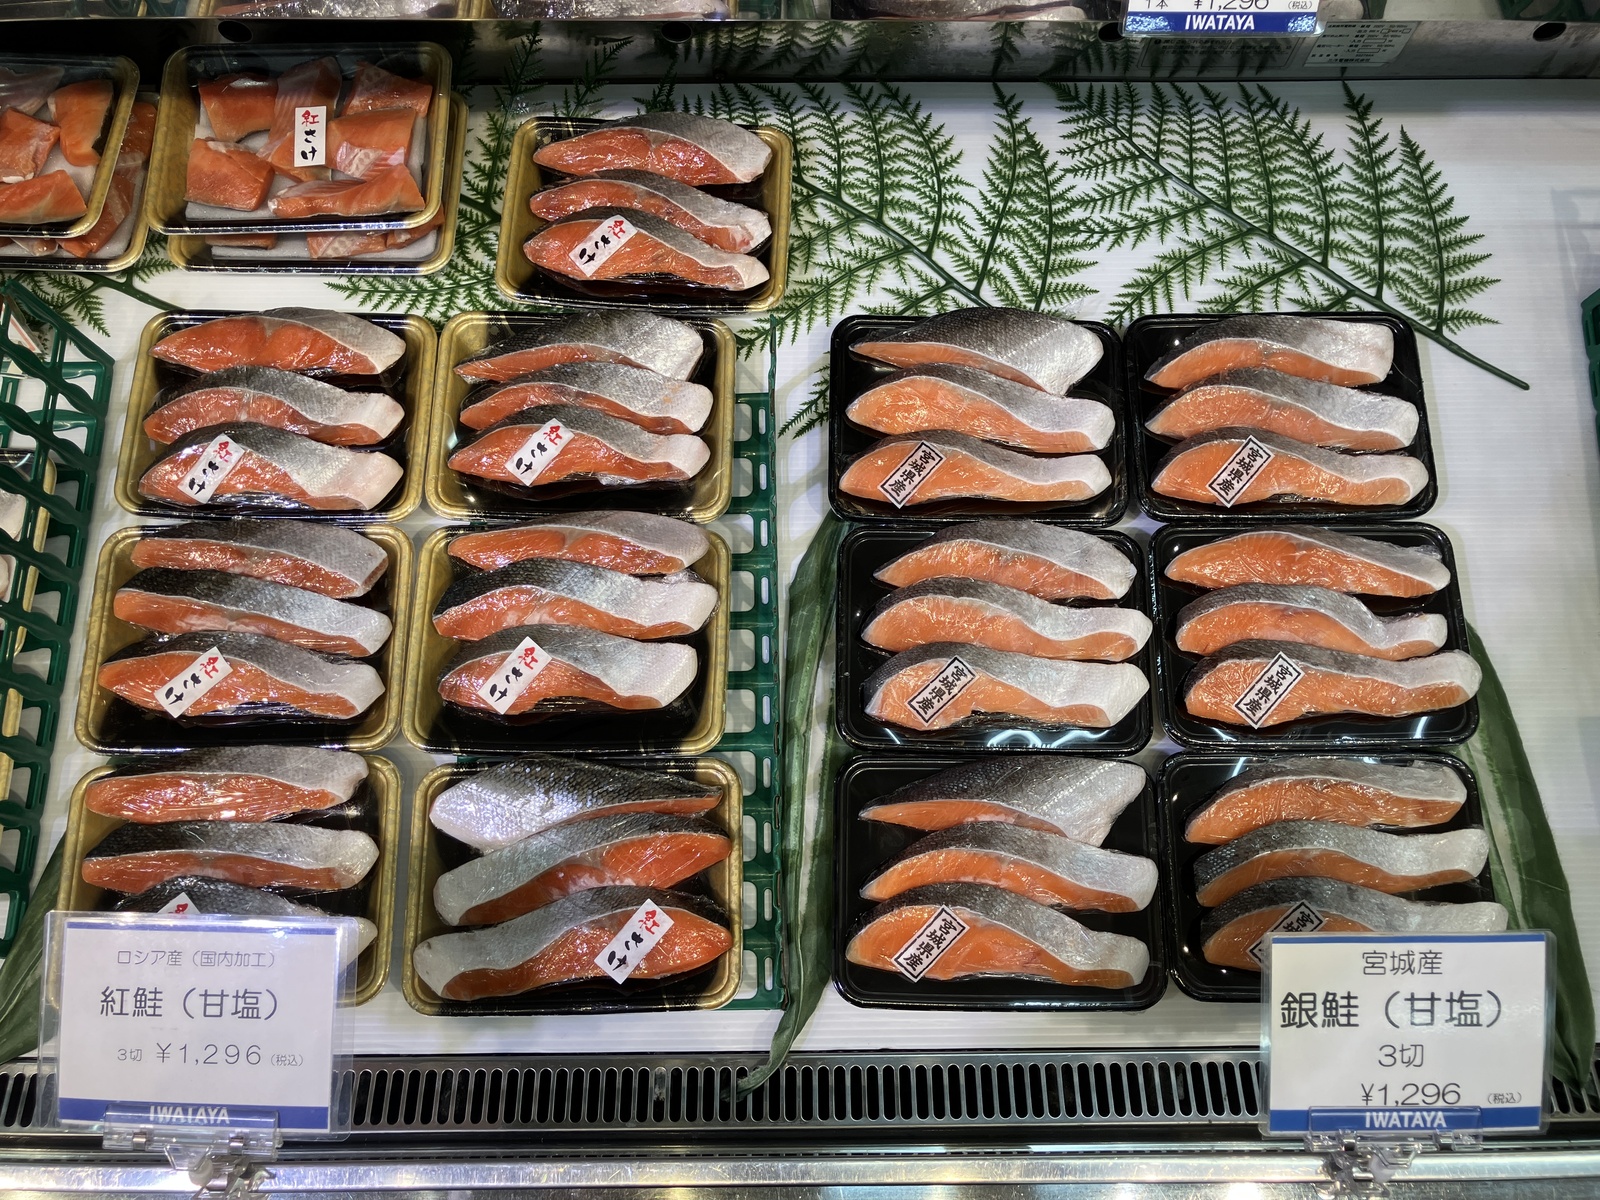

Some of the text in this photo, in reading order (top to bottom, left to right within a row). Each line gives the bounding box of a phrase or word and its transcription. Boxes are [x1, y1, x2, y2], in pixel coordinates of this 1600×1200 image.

[1184, 14, 1255, 31] IWATAYA
[301, 110, 320, 161] 紅さけ
[579, 220, 625, 265] 紅さけ
[188, 440, 233, 496] 紅さけ
[515, 425, 562, 474] 紅さけ
[889, 448, 936, 497] 宮城県産
[1216, 446, 1264, 496] 宮城県産
[164, 656, 219, 706] 紅さけ
[489, 646, 539, 702] 紅さけ
[915, 664, 969, 714] 宮城県産
[1243, 663, 1293, 717] 宮城県産
[117, 949, 275, 967] ロシア産（国内加工）
[607, 909, 664, 970] 紅さけ
[903, 913, 957, 971] 宮城県産
[1362, 949, 1443, 975] 宮城産
[99, 985, 278, 1021] 紅鮭（甘塩）
[1280, 989, 1502, 1029] 銀鮭（甘塩）
[117, 1043, 304, 1067] 3切 ¥1,296 （税込）
[1377, 1043, 1424, 1068] 3切
[149, 1105, 230, 1124] IWATAYA
[1361, 1082, 1522, 1107] ¥1,296 （税込）
[1364, 1110, 1447, 1129] IWATAYA
